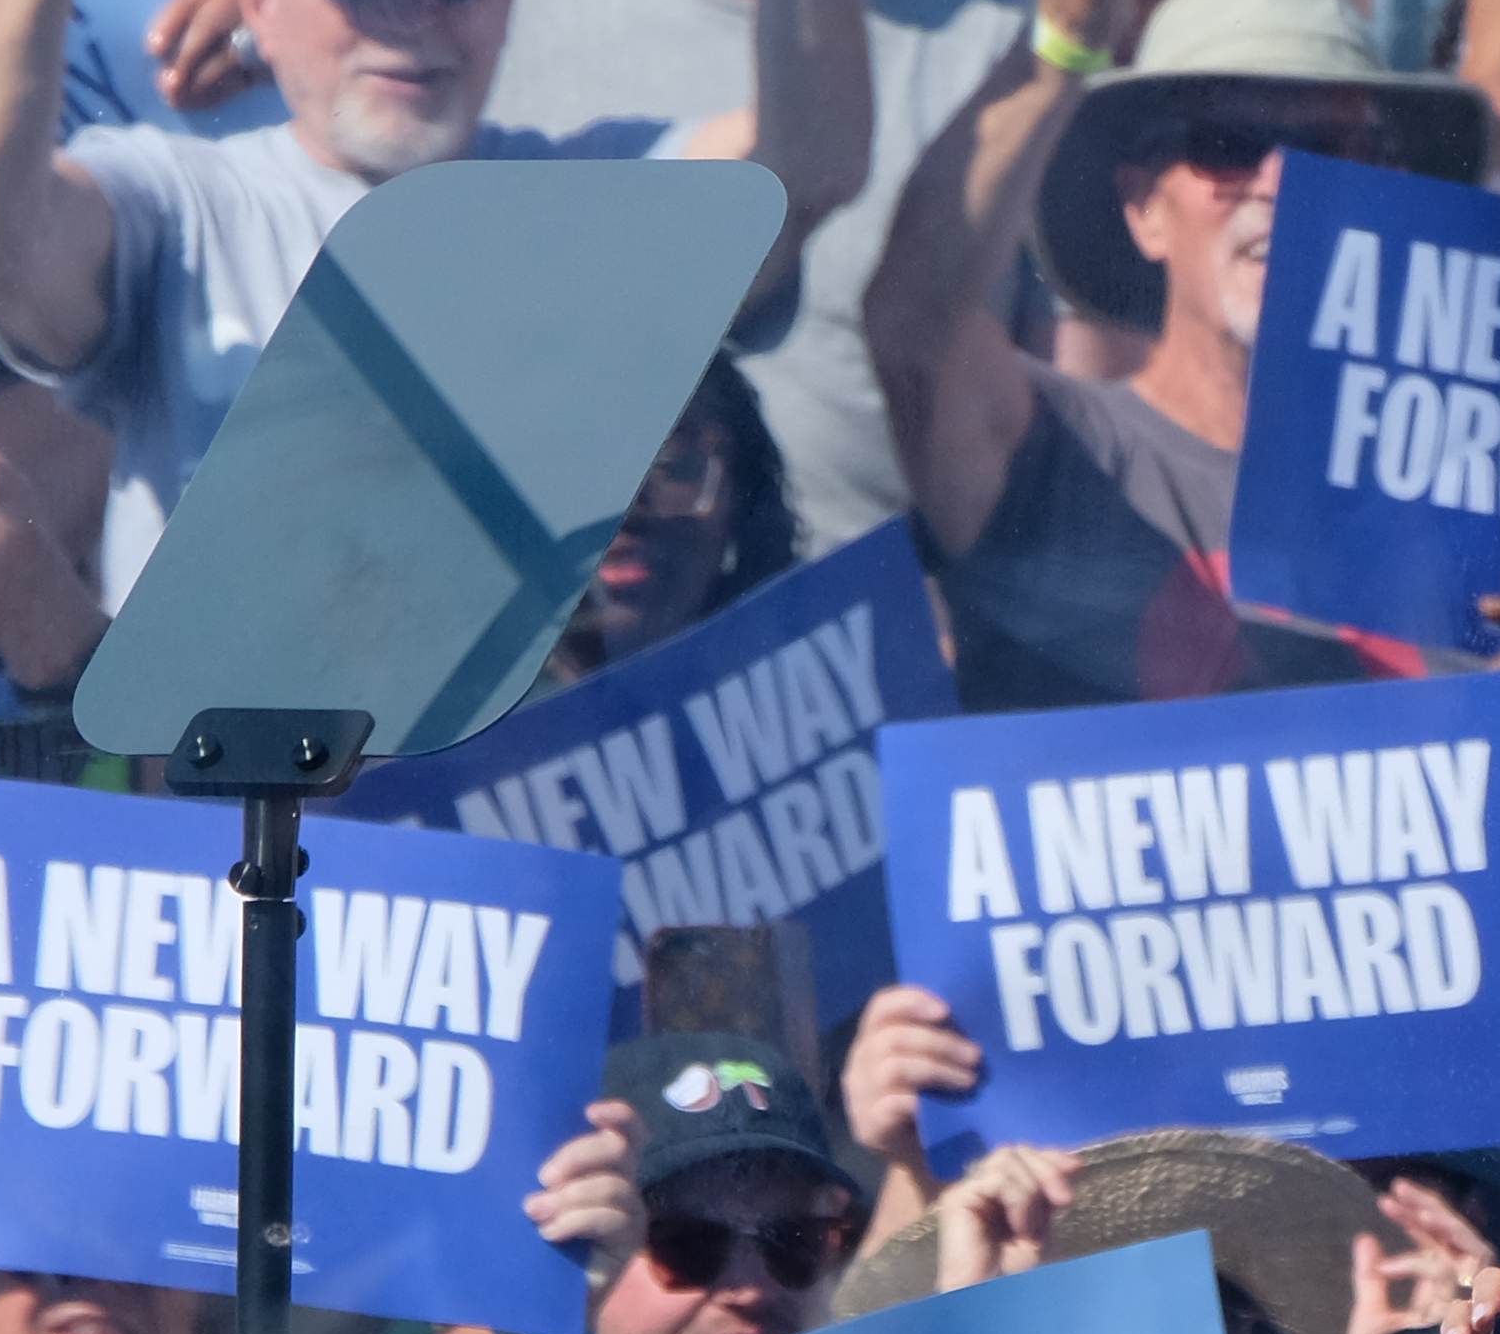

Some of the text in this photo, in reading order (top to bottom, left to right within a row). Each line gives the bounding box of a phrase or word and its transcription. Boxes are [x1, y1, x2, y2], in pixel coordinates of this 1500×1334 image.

[1308, 226, 1383, 356] A
[684, 602, 886, 807] WAY
[948, 739, 1491, 924] A NEW WAY
[311, 888, 552, 1041] WAY
[988, 882, 1483, 1053] FORWARD
